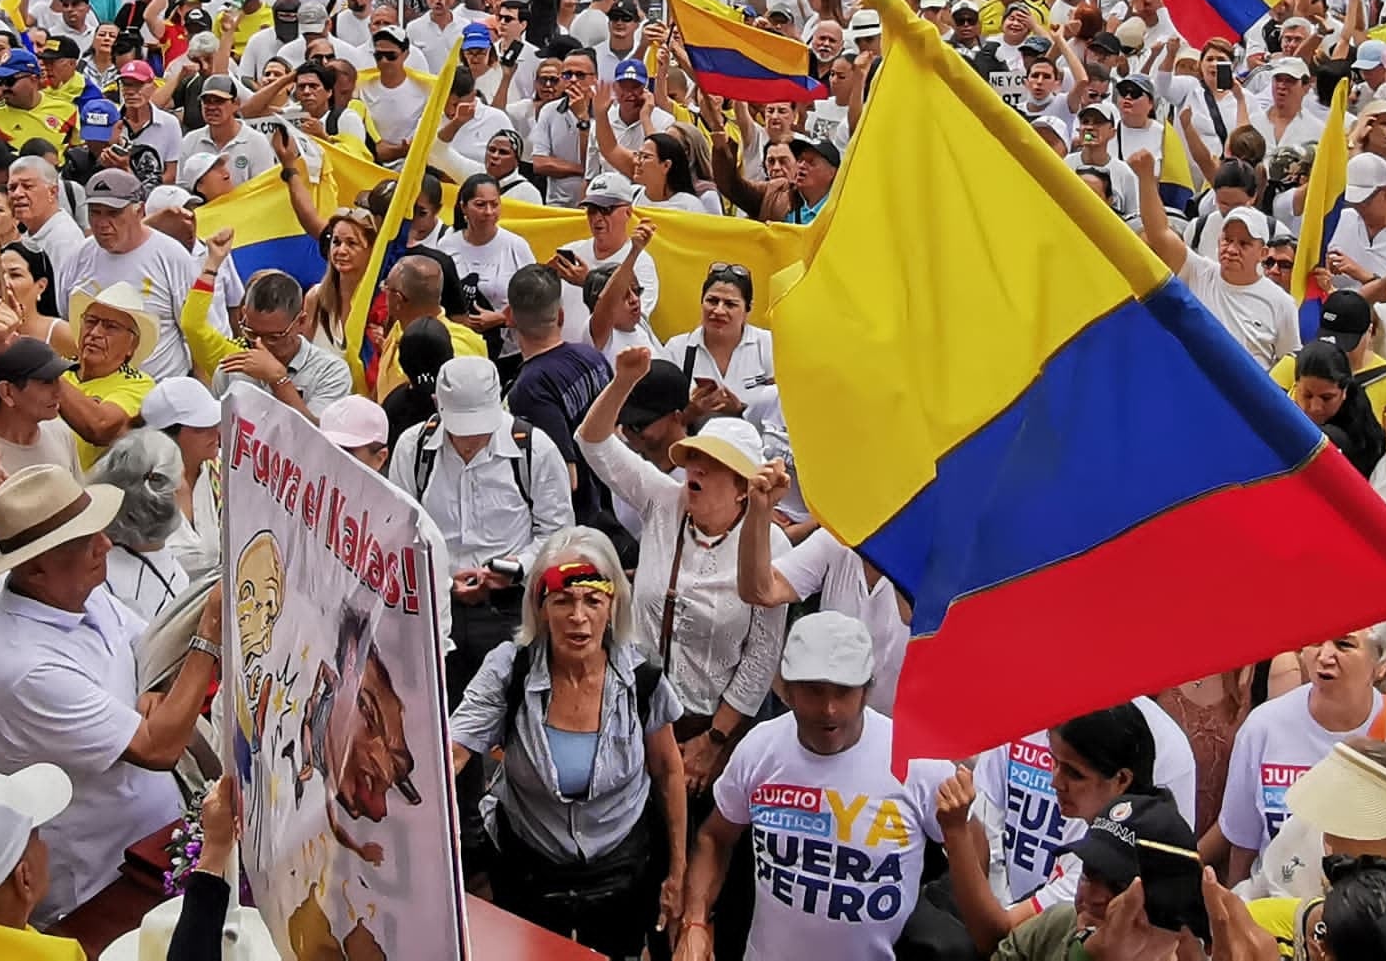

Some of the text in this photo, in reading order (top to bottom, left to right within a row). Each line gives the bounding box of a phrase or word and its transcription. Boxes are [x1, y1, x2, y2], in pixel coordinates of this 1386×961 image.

[229, 414, 302, 516] Fuera
[753, 788, 910, 849] JUICIO YA
[752, 823, 903, 883] FUERA
[756, 855, 902, 922] PETRO
